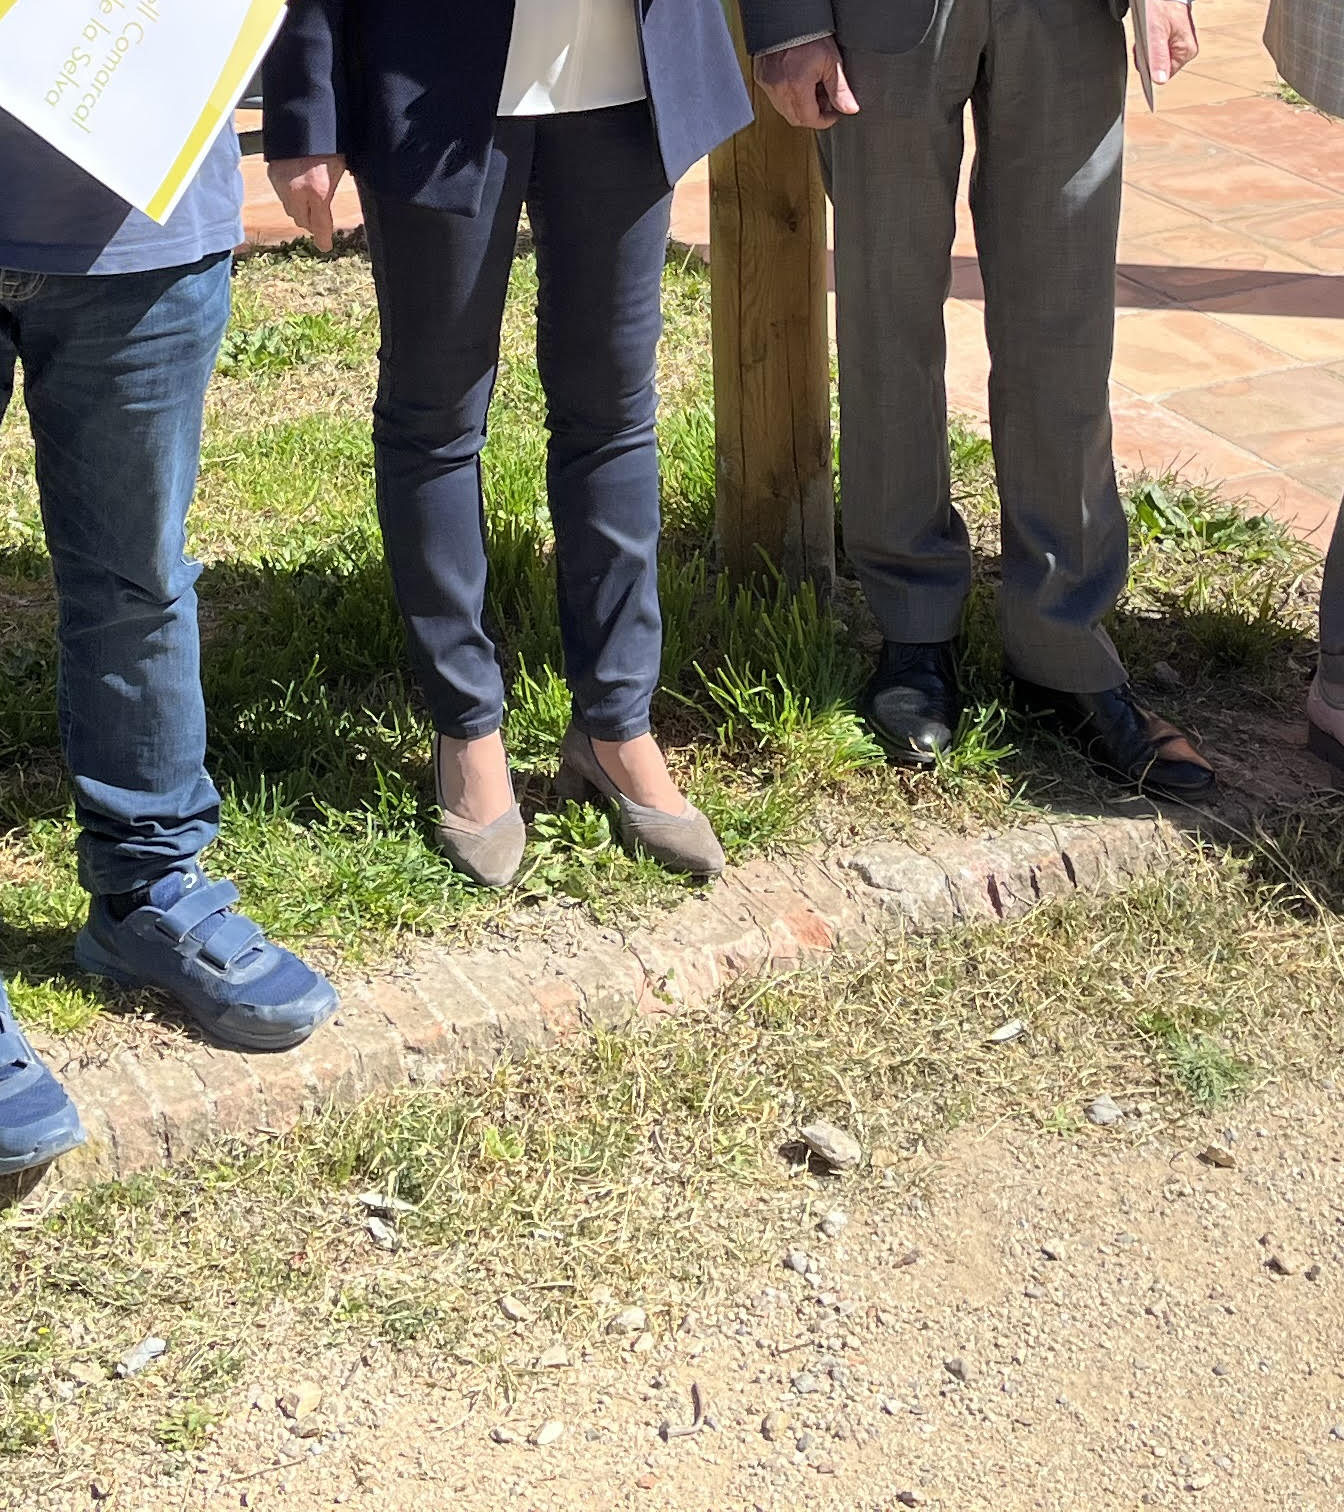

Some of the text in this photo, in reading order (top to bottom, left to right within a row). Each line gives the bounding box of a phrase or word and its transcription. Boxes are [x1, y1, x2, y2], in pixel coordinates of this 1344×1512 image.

[82, 17, 111, 42] la
[44, 46, 91, 107] Selva
[71, 22, 144, 134] Comarcal
